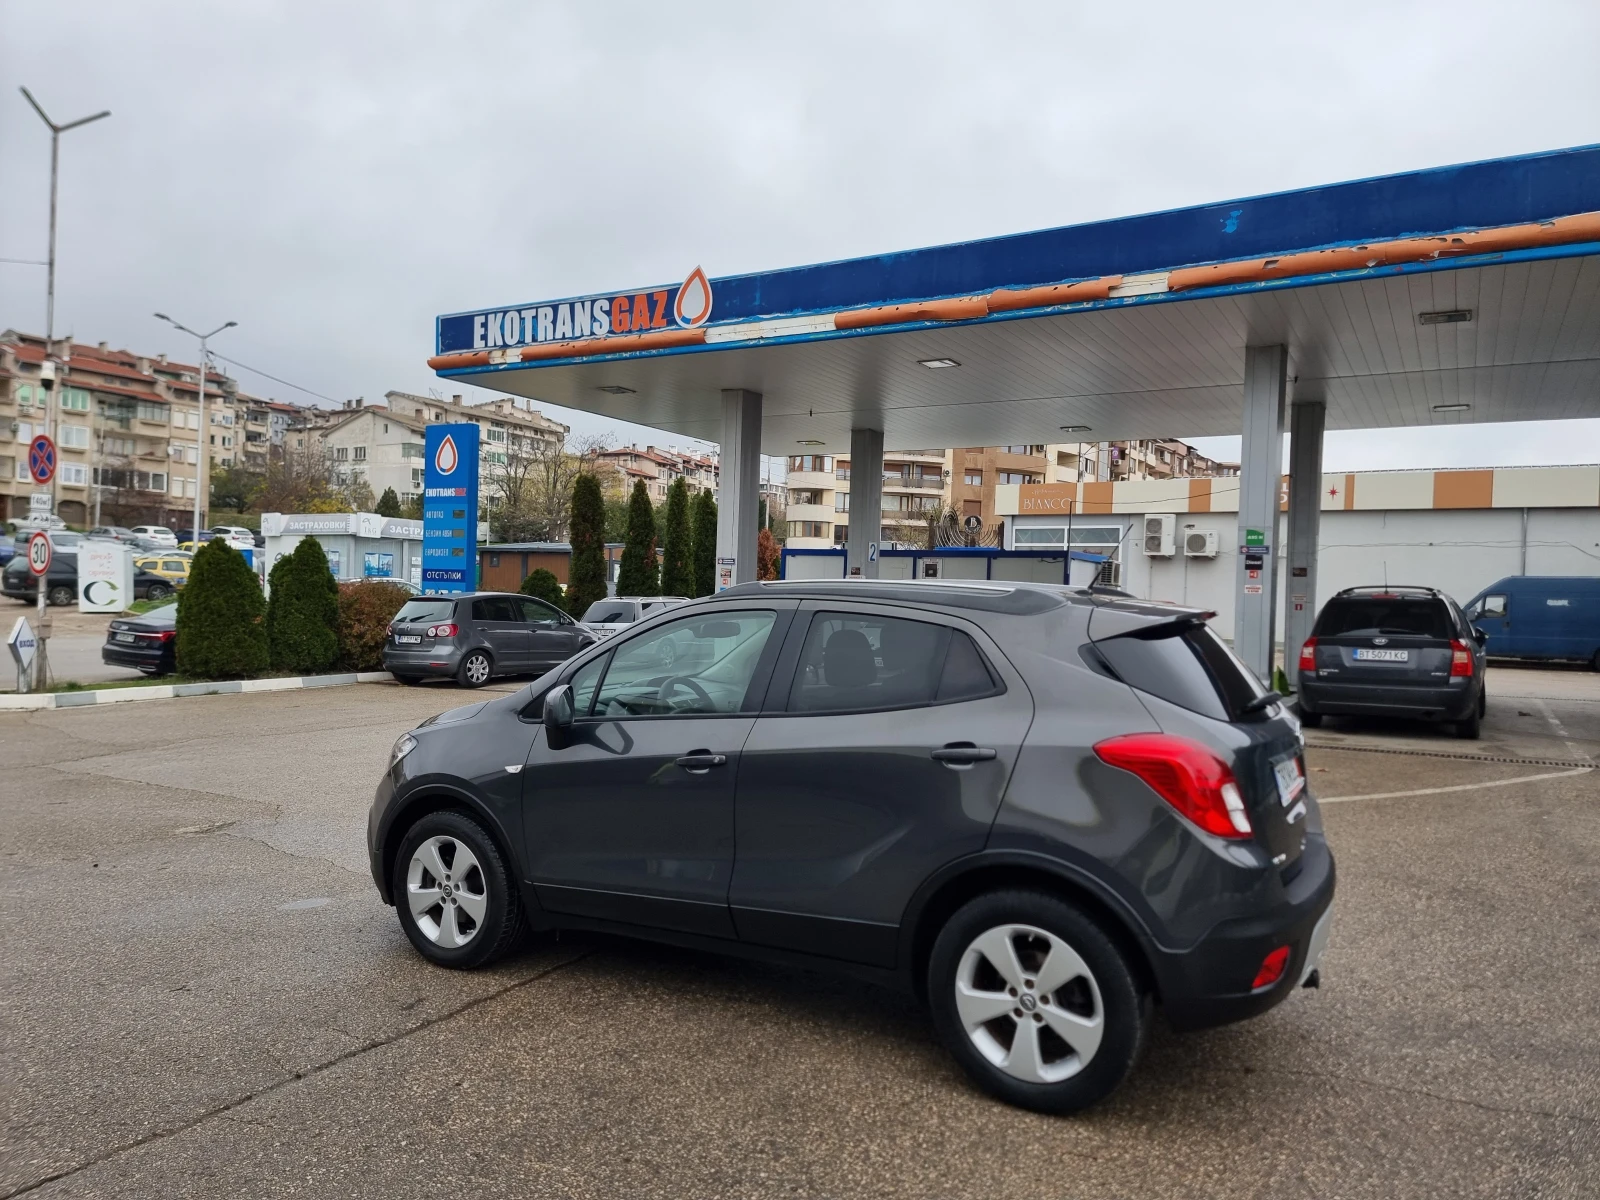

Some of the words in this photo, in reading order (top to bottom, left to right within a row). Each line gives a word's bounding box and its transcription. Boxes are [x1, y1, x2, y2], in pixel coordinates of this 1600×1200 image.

[473, 290, 668, 349] EKOTRANSGAZ
[1023, 497, 1072, 510] BIANCO
[289, 521, 346, 530] ЗАСТРАХОВКИ
[33, 543, 46, 564] 30
[870, 543, 876, 561] 2
[426, 571, 462, 580] ОТСТЪПКИ
[19, 638, 35, 649] ВХОД
